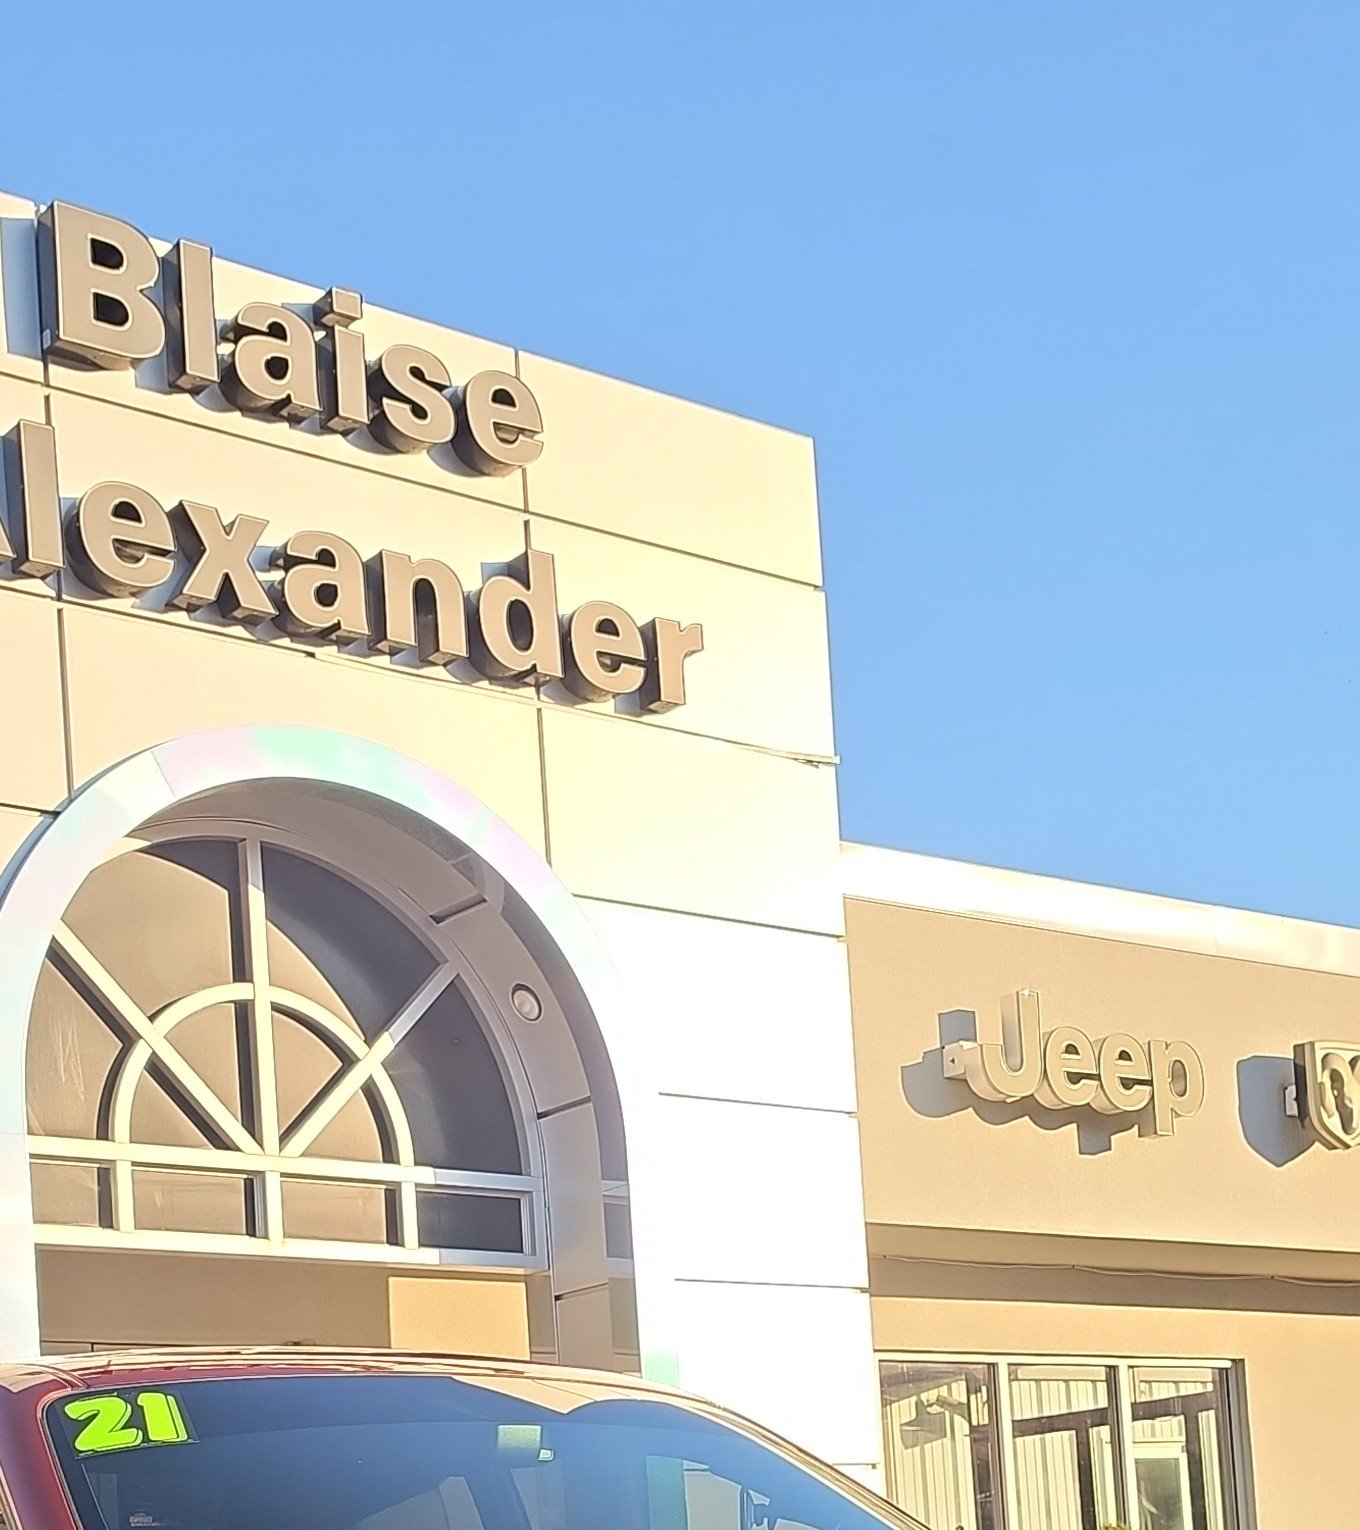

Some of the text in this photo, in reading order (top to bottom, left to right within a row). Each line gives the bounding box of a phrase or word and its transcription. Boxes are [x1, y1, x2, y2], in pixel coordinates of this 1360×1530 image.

[40, 198, 545, 474] Blaise
[970, 988, 1204, 1136] Jeep
[64, 1391, 188, 1452] 21
